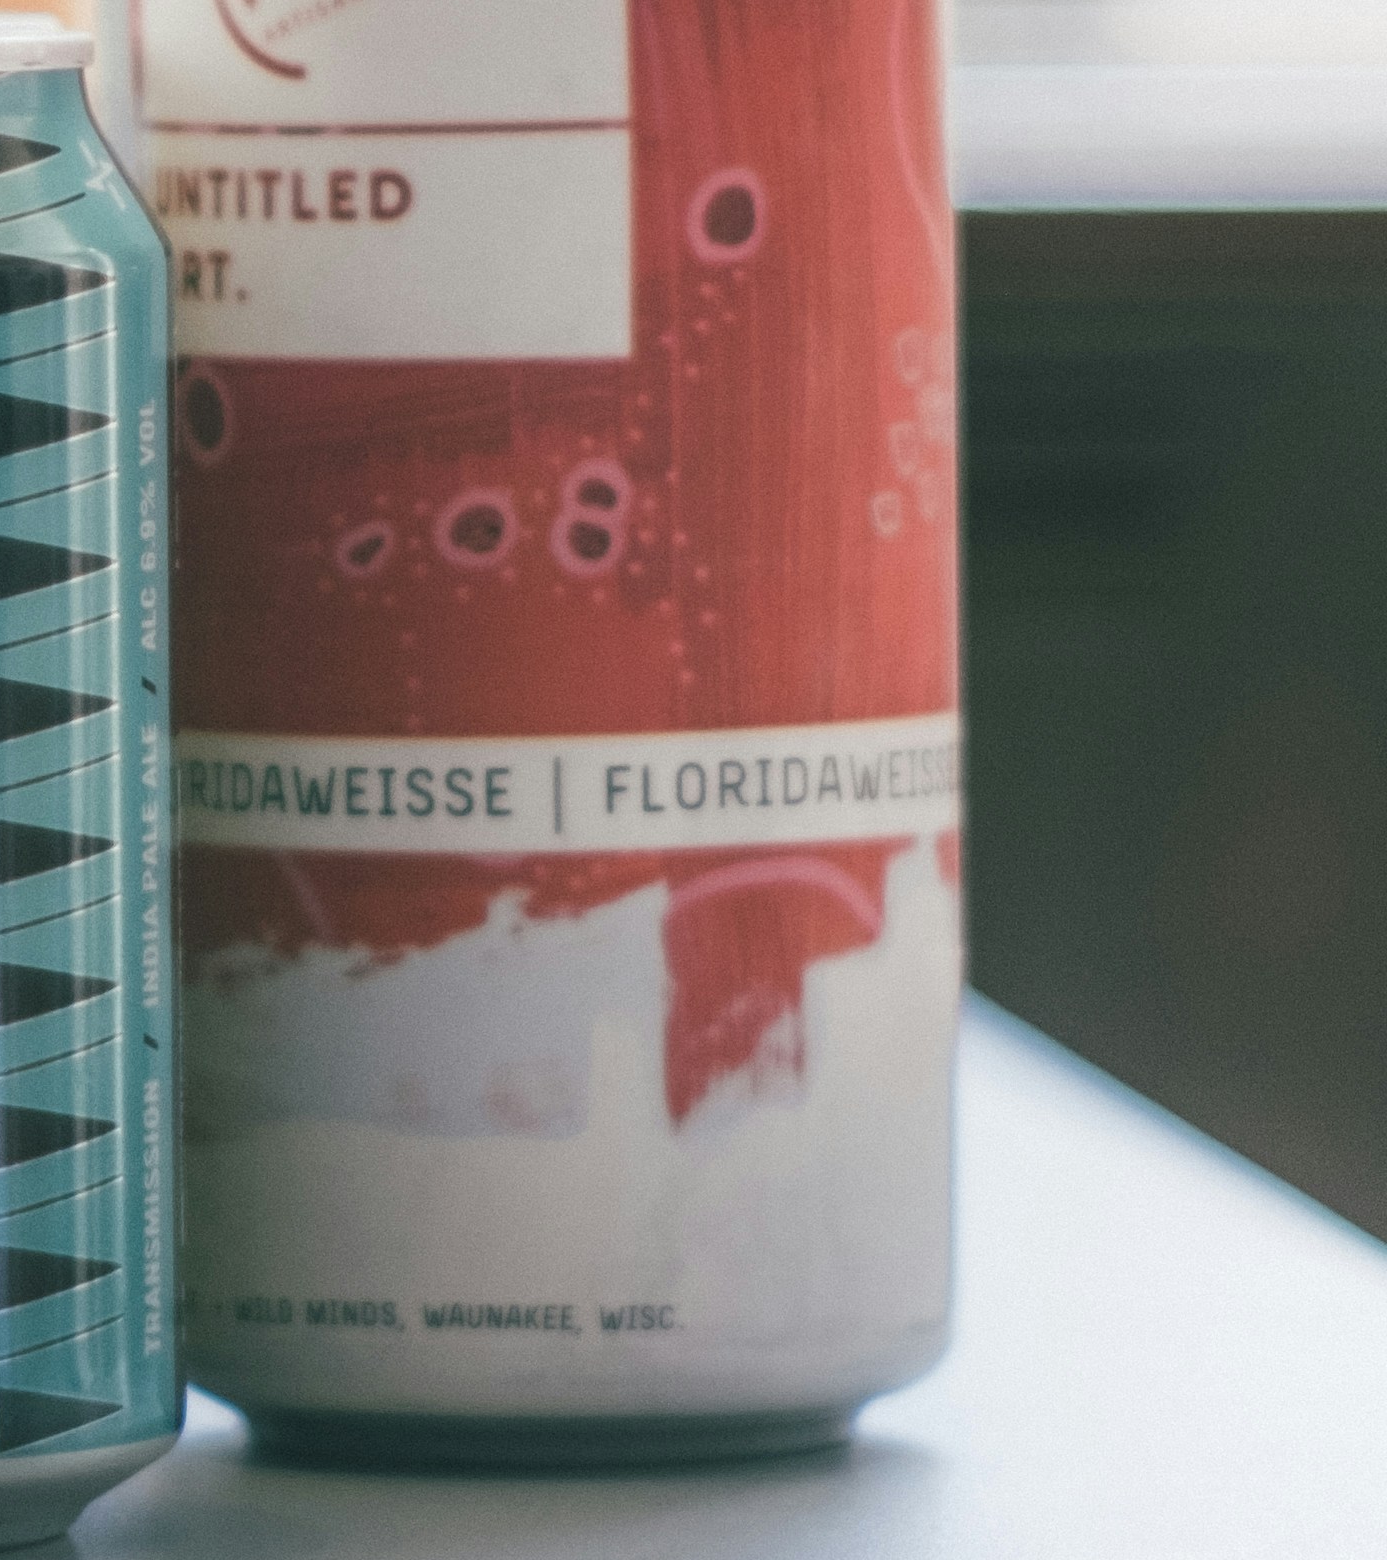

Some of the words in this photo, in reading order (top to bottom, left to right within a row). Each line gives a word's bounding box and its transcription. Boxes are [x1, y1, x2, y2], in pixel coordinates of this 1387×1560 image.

[156, 165, 415, 222] UNTITLED
[181, 248, 250, 304] RT.
[138, 397, 157, 467] VOL
[139, 586, 157, 651] ALC
[140, 722, 159, 789] ALE
[180, 757, 513, 818] RIDAWEISSE
[140, 800, 159, 894] PALE
[141, 903, 160, 1009] INDIA
[141, 1077, 162, 1357] TRANSMISSION
[305, 1297, 407, 1333] MINDS,
[421, 1301, 585, 1336] WAUNAKEE,
[599, 1304, 685, 1333] WISC.
